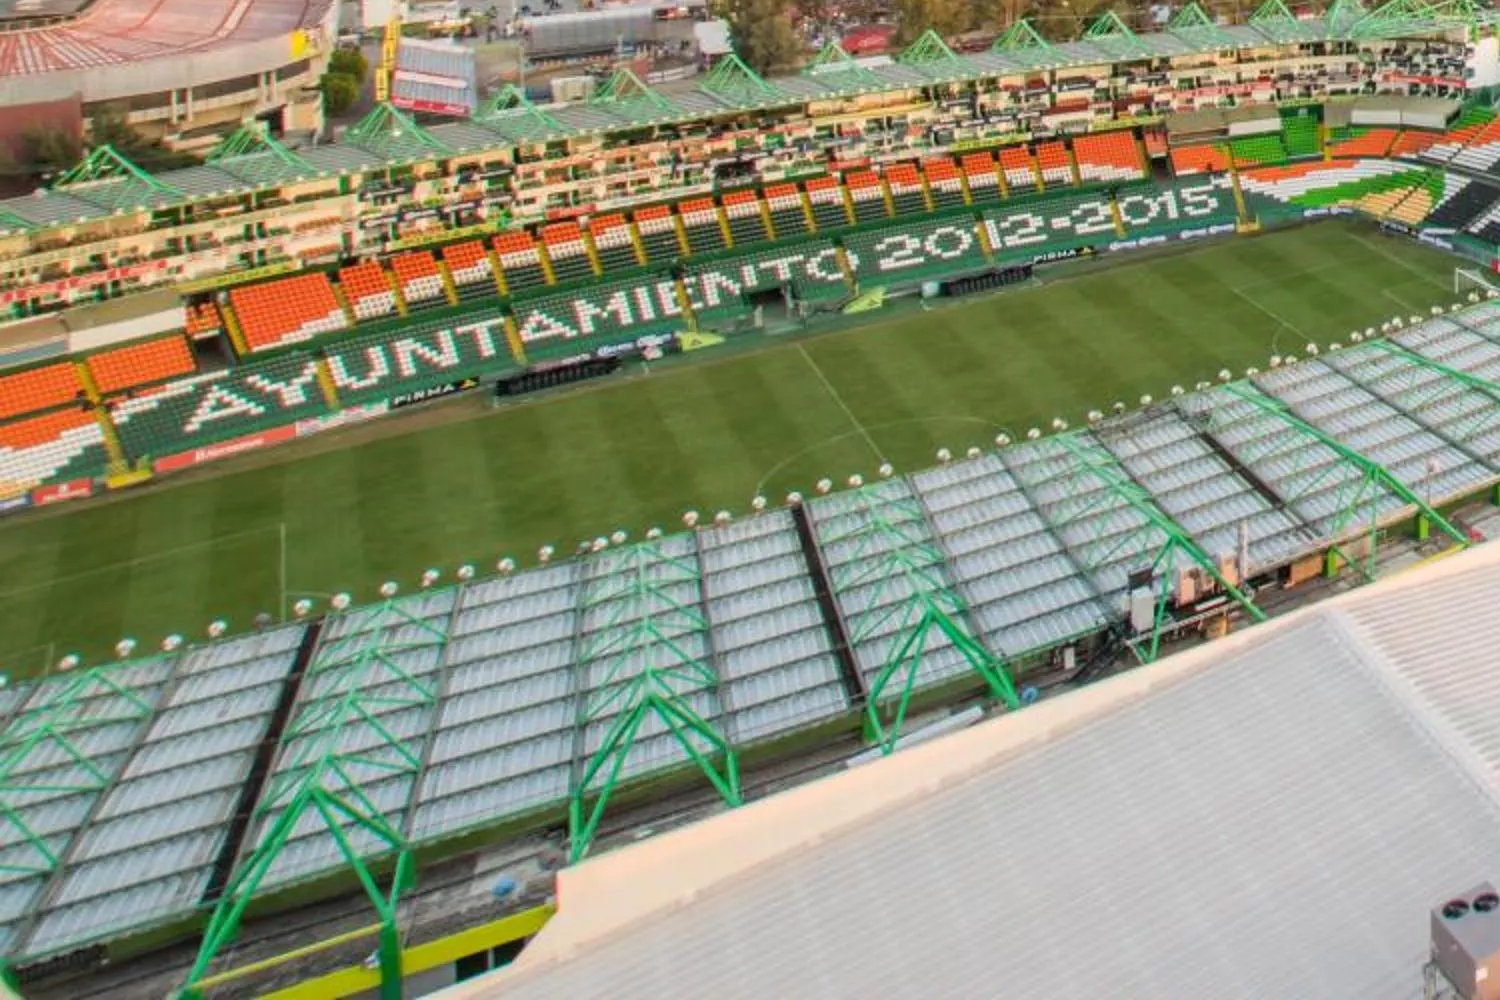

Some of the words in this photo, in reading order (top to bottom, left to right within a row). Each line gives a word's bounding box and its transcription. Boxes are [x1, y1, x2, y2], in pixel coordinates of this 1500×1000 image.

[183, 248, 859, 433] AYUNTAMIENTO
[874, 185, 1220, 271] 2012-2015
[393, 383, 455, 406] PIRMA
